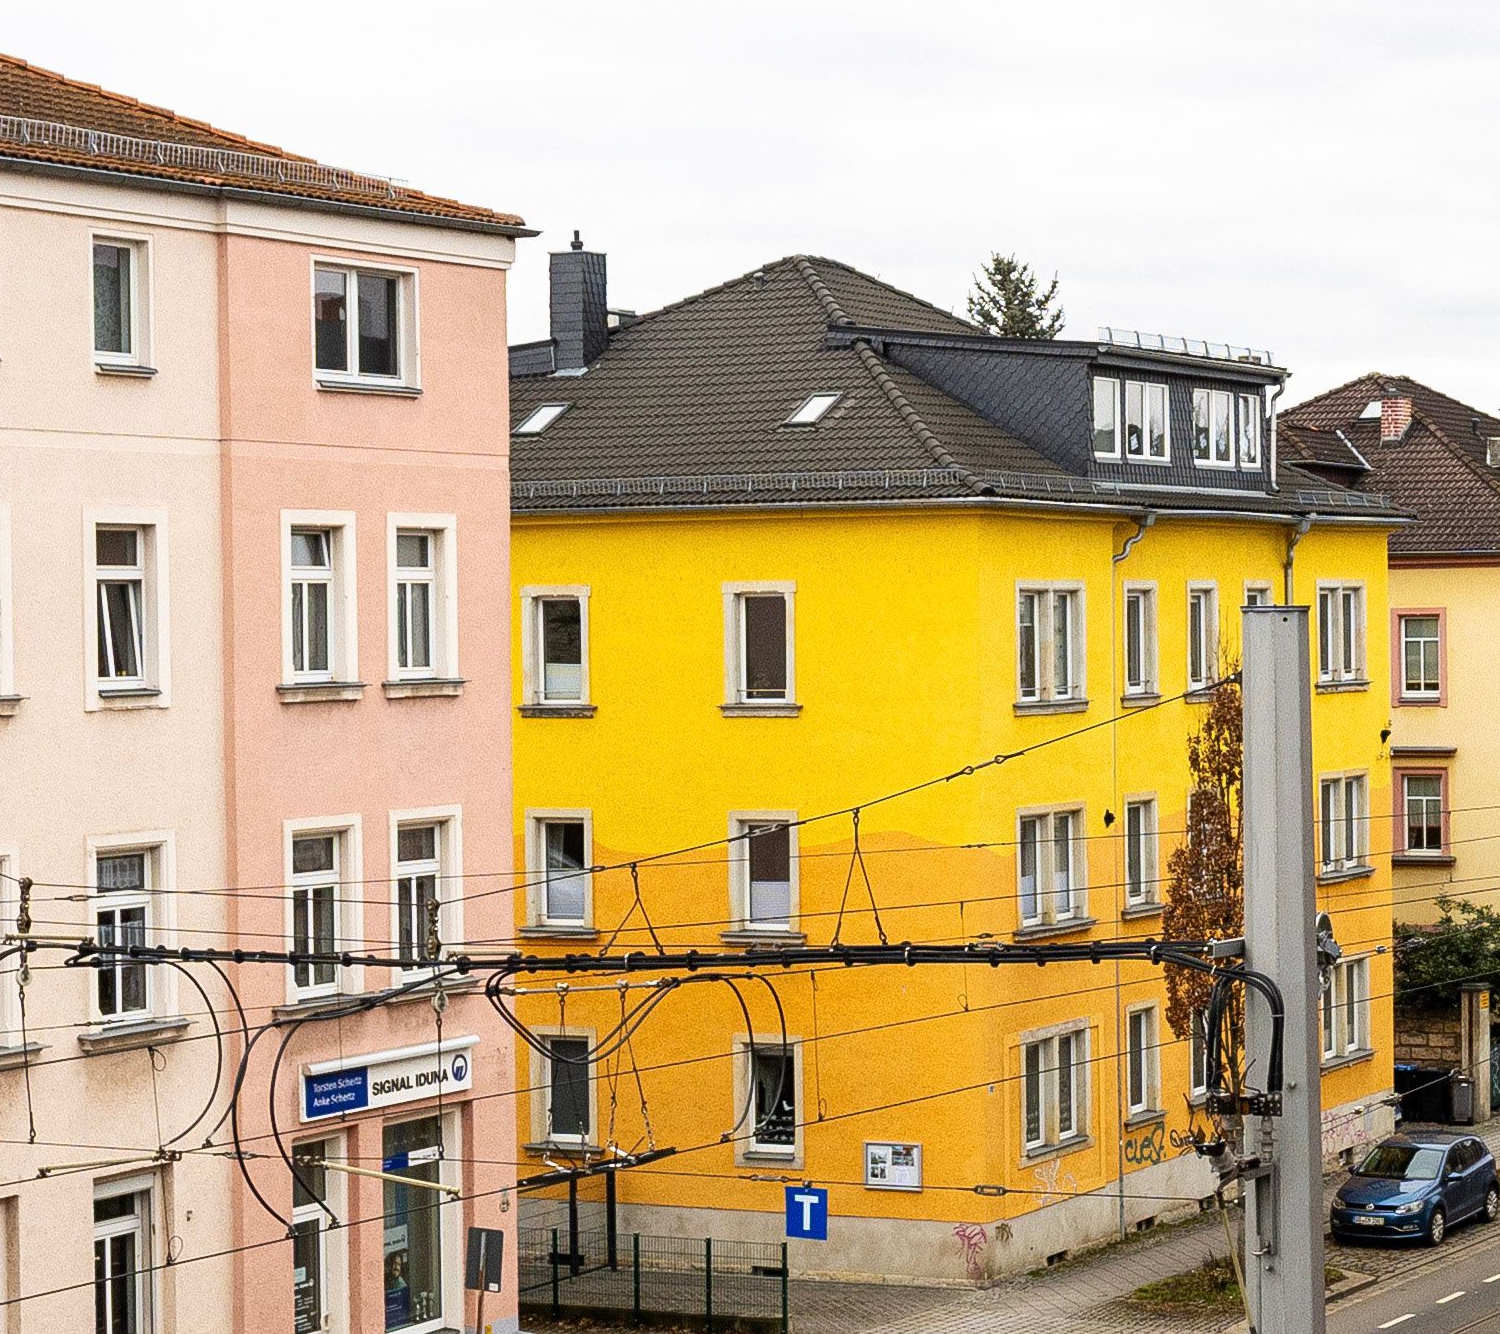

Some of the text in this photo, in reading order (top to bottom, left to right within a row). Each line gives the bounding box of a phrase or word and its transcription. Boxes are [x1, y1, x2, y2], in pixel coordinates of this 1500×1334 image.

[313, 1081, 337, 1093] Torsten
[372, 1069, 449, 1096] SIGNAL IDUNA
[313, 1097, 330, 1107] Anke
[794, 1194, 819, 1231] T
